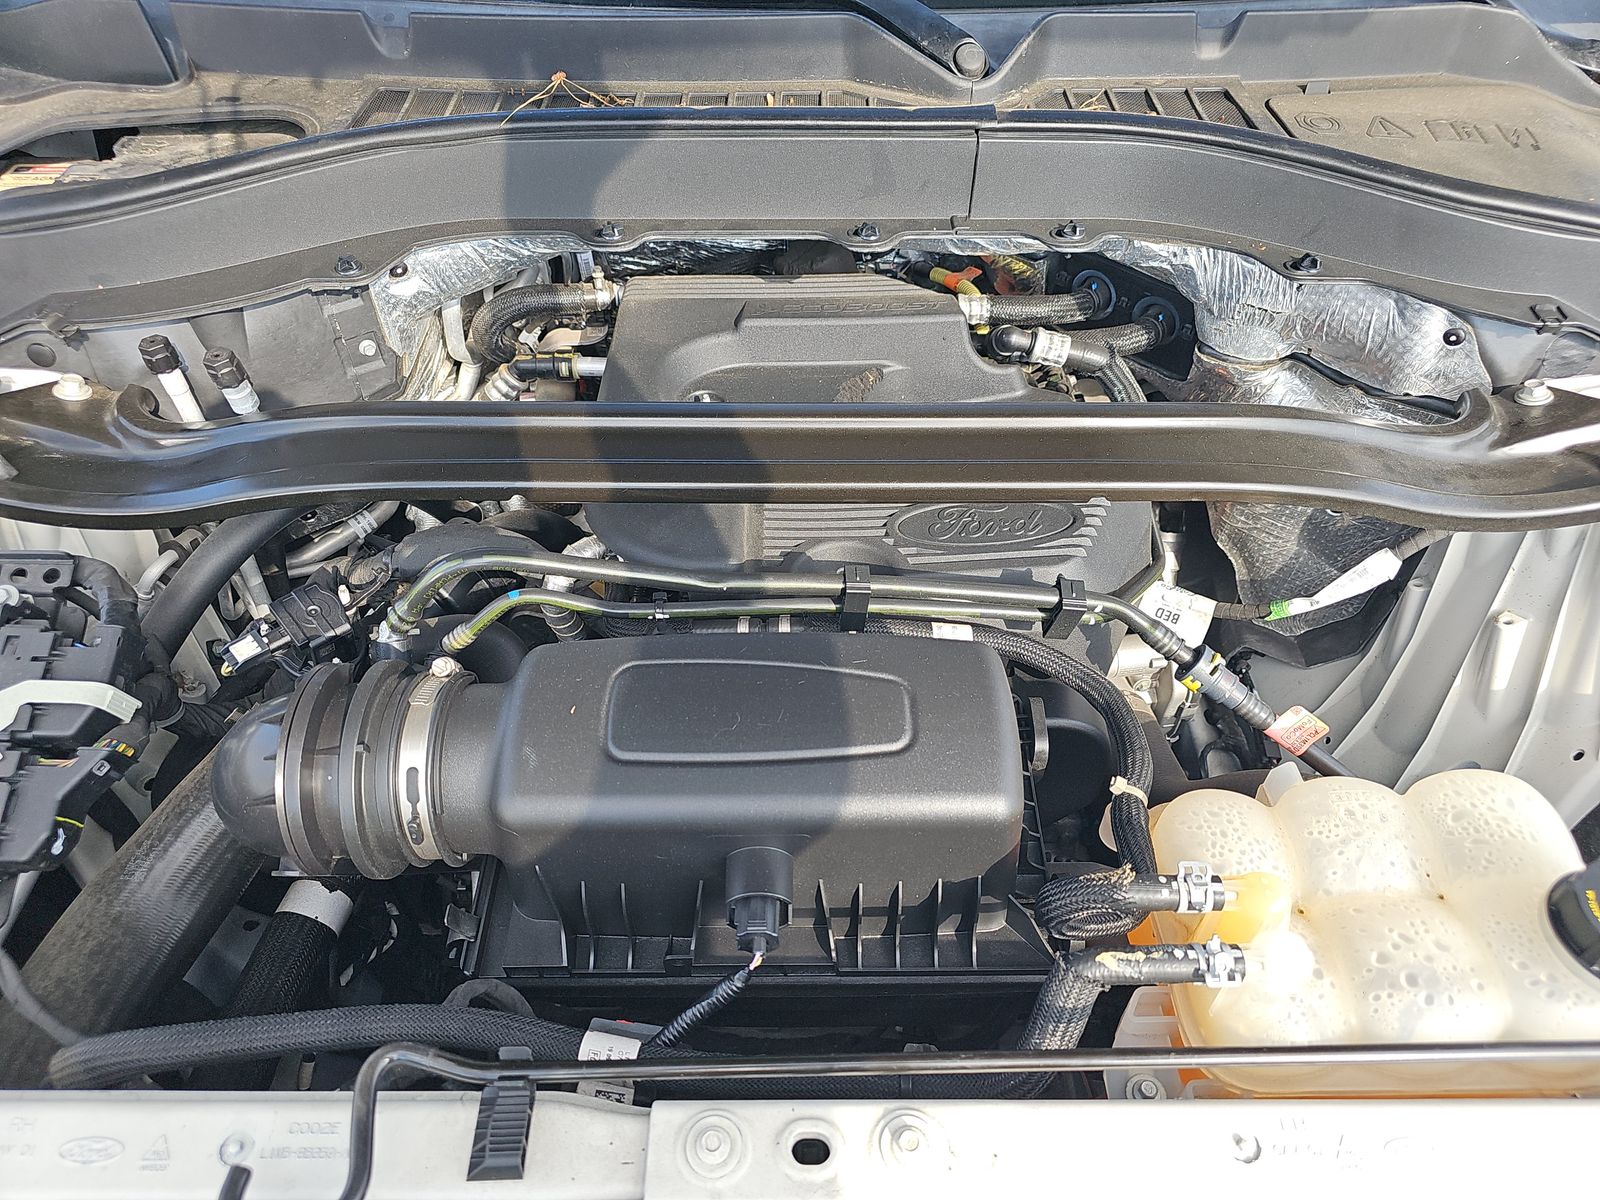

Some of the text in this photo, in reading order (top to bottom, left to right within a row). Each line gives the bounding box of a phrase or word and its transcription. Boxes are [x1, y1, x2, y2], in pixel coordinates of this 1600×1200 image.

[782, 300, 948, 315] ECOBOOST
[927, 503, 1044, 541] Ford
[1154, 607, 1181, 625] BED
[1286, 718, 1313, 740] FoMoCo
